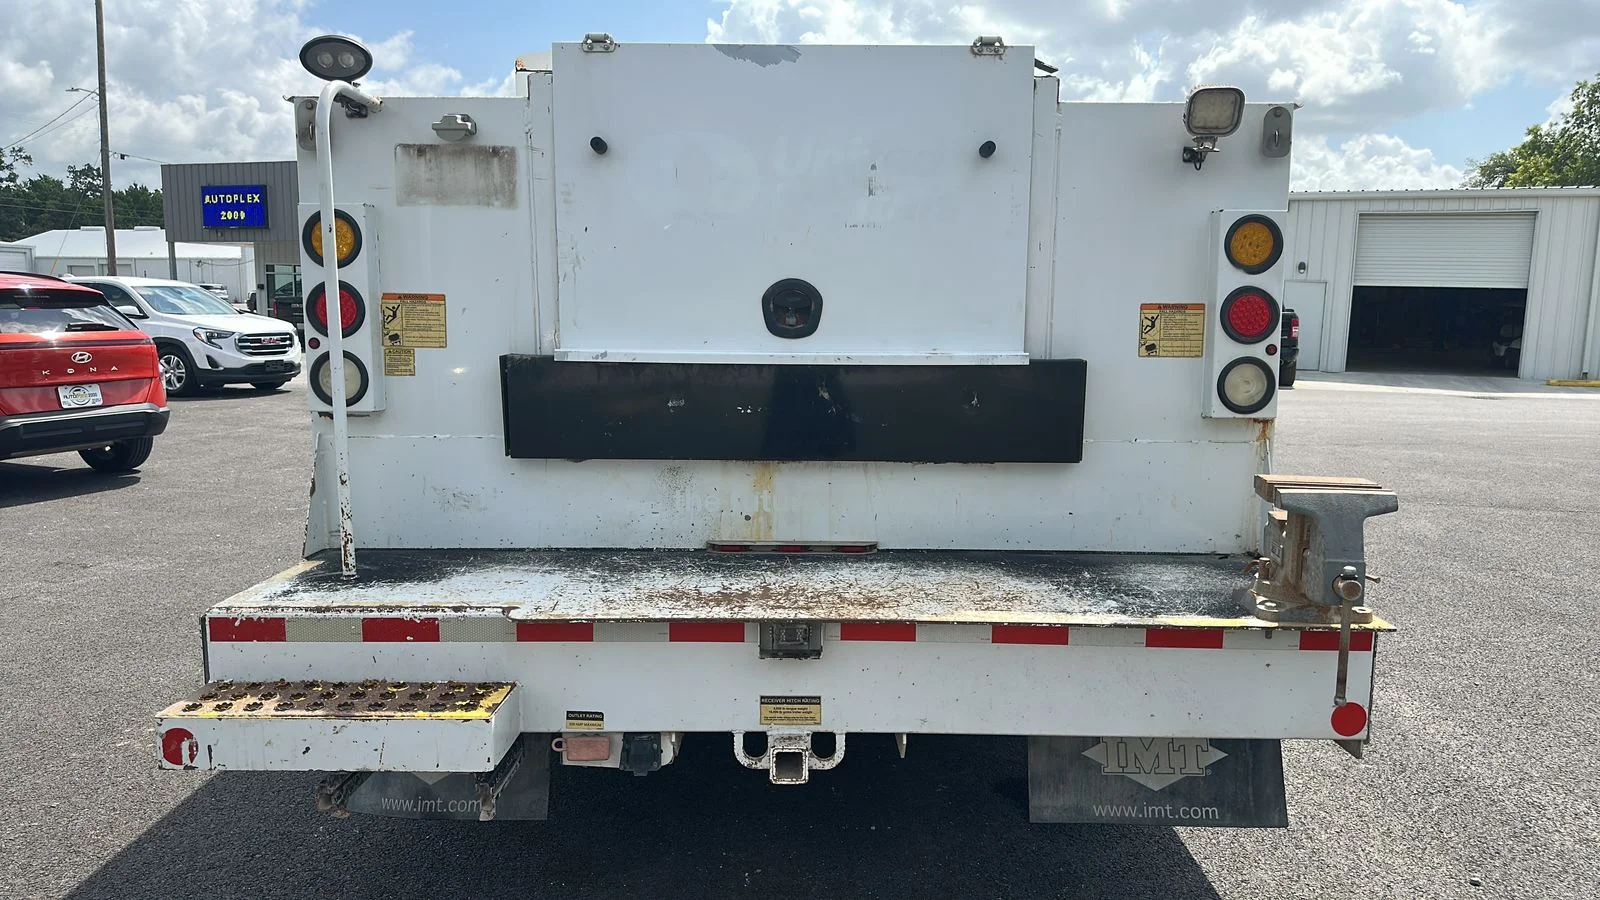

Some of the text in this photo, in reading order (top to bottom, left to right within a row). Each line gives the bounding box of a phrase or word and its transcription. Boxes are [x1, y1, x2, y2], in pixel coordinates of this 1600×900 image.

[204, 193, 260, 204] AUTOPLEX
[220, 210, 246, 220] 2000
[42, 365, 119, 375] KONA
[1101, 737, 1209, 775] IMT
[381, 796, 481, 812] www.imt.com
[1093, 802, 1219, 819] www.imt.com
